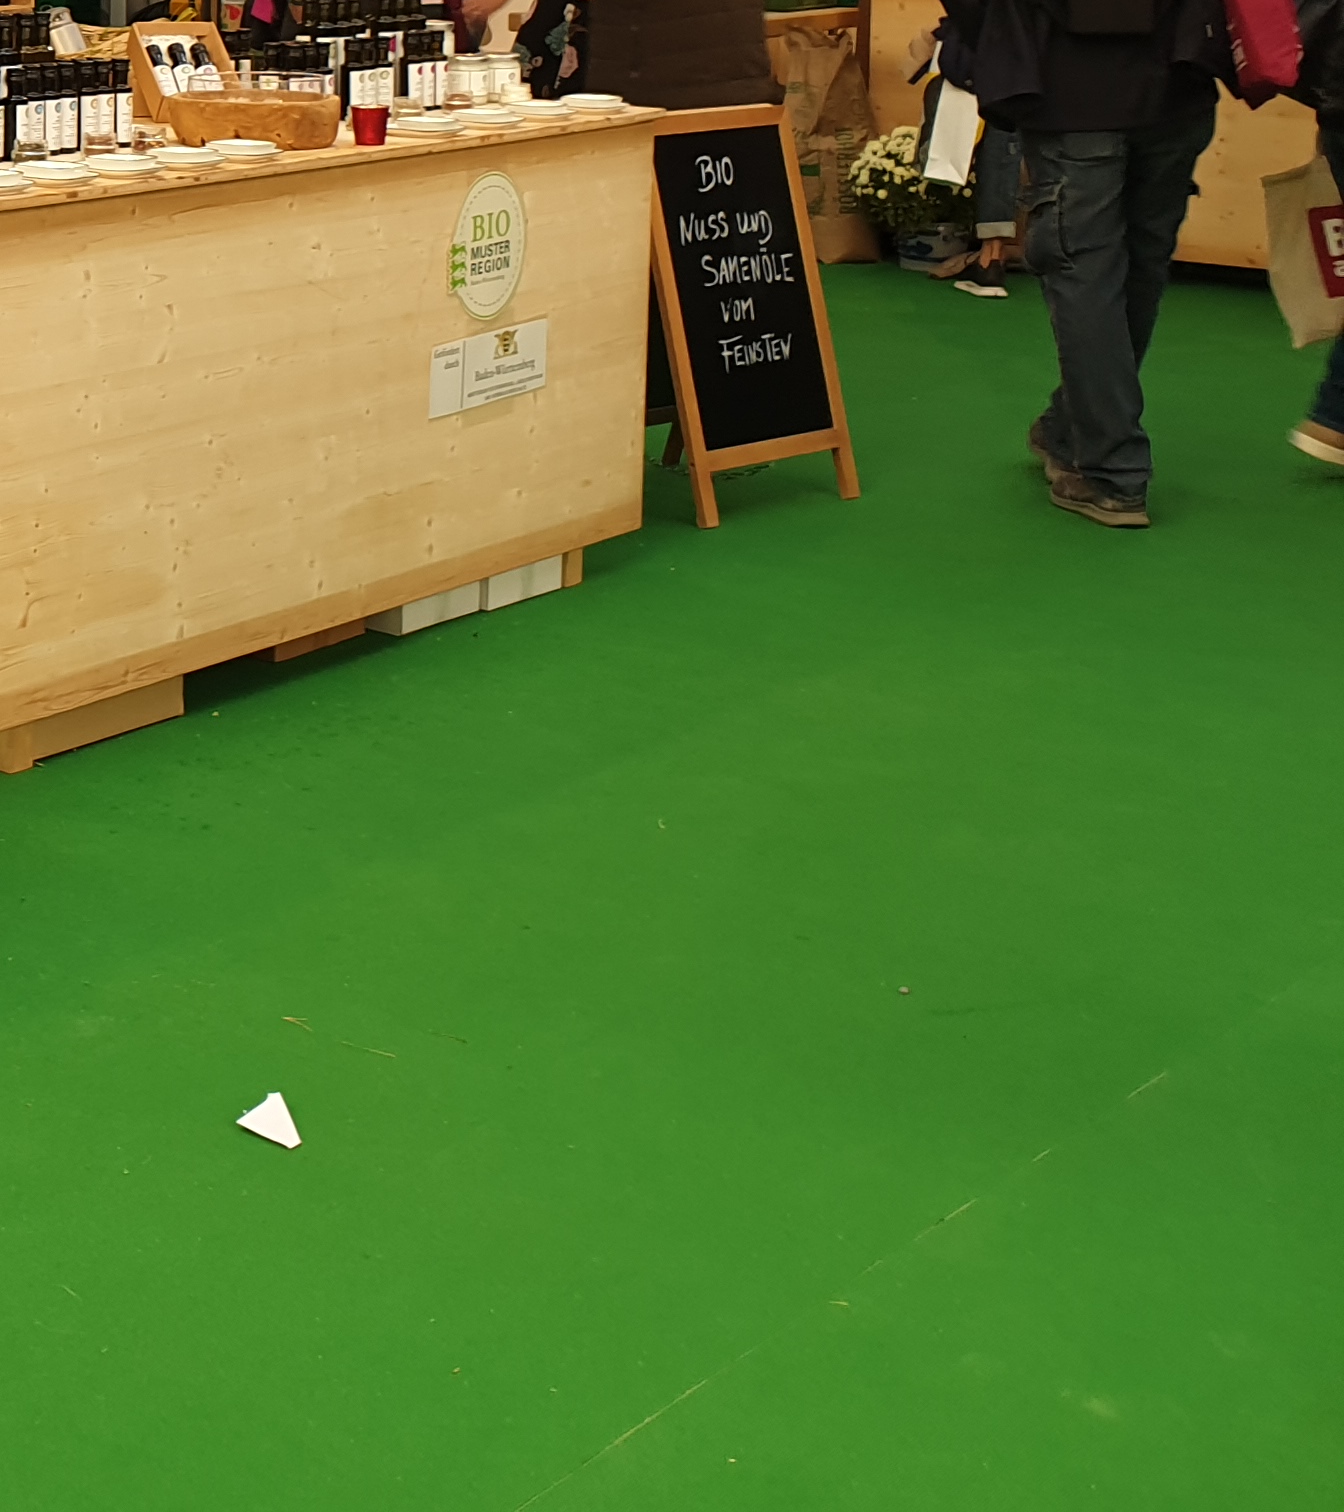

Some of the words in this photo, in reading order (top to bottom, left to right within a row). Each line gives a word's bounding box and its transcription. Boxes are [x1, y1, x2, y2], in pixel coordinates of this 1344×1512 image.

[695, 155, 734, 193] BIO
[471, 209, 511, 243] BIO
[470, 240, 511, 261] MUSTER
[470, 255, 511, 276] REGION
[701, 247, 795, 287] SAMENÖLE
